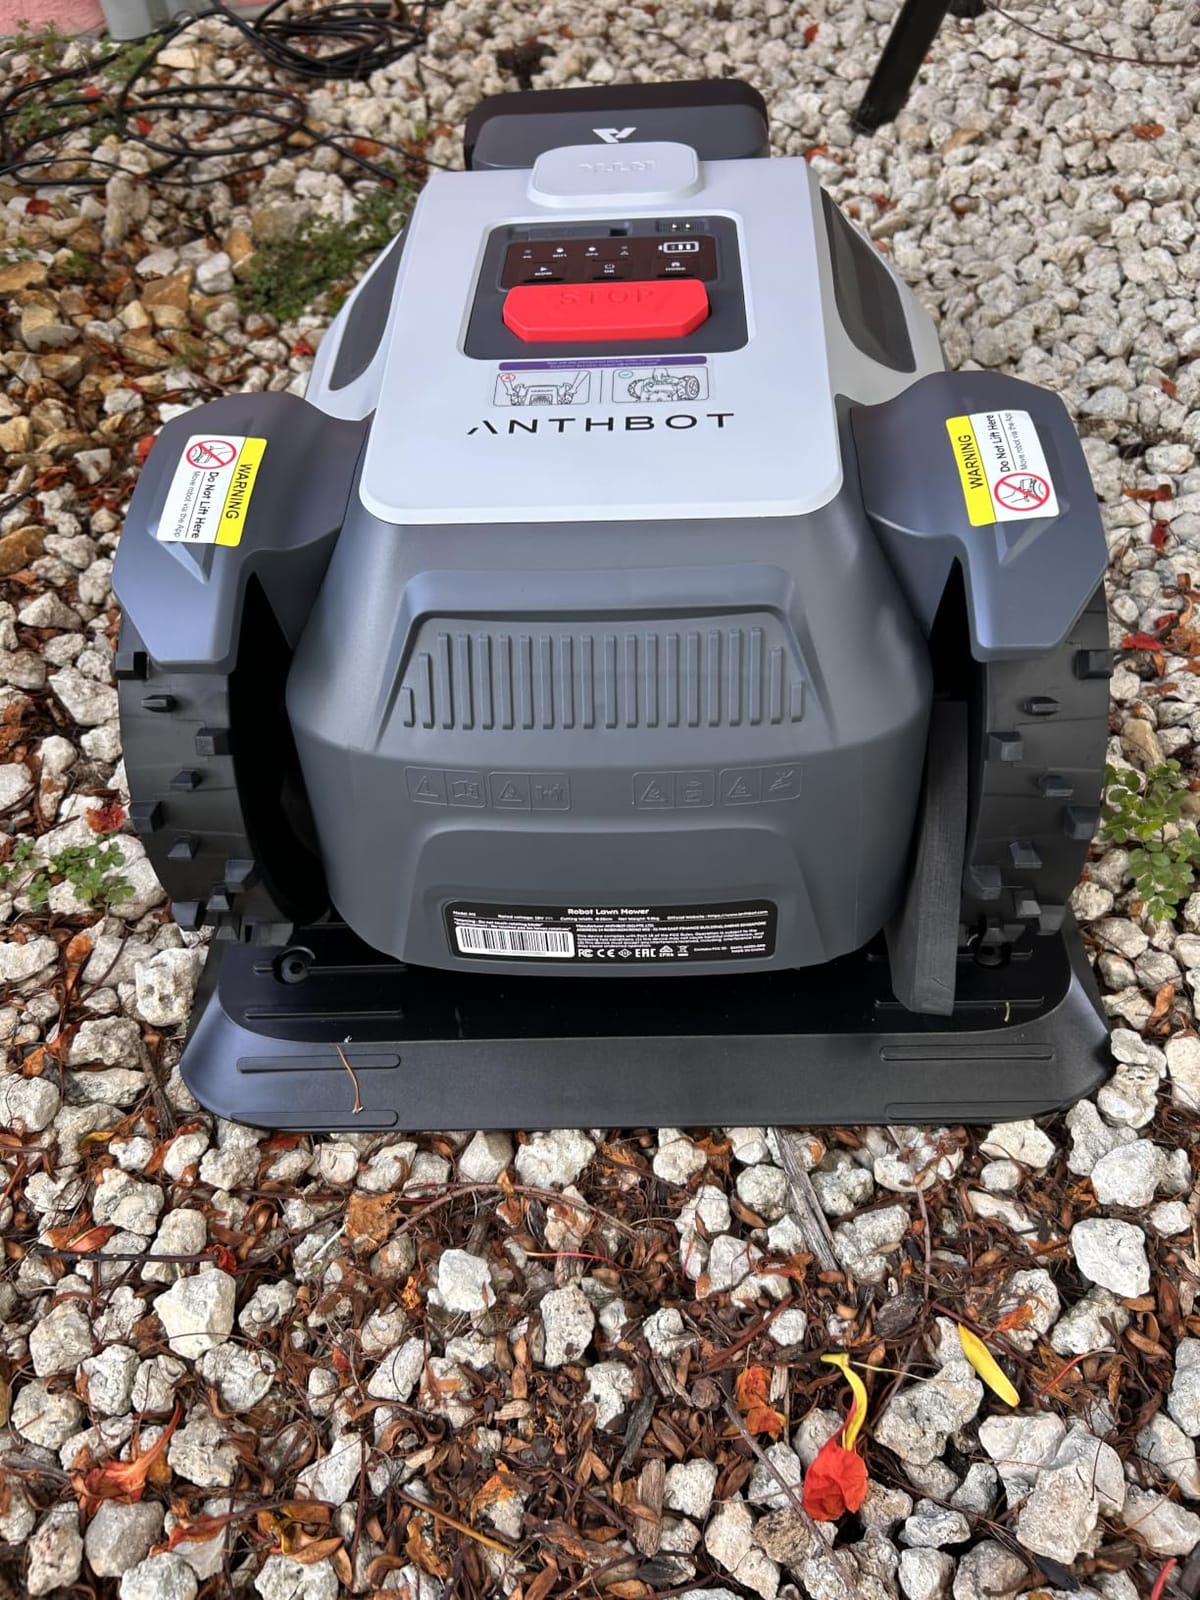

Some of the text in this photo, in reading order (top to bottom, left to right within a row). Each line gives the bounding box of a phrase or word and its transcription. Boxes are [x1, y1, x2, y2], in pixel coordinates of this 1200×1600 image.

[559, 286, 655, 305] STOP
[467, 412, 734, 434] ANTHBOT
[986, 414, 1011, 473] Do Not Lift Here
[957, 434, 984, 490] WARNING
[191, 471, 219, 539] Do Not Lift Here
[226, 463, 254, 519] WARNING
